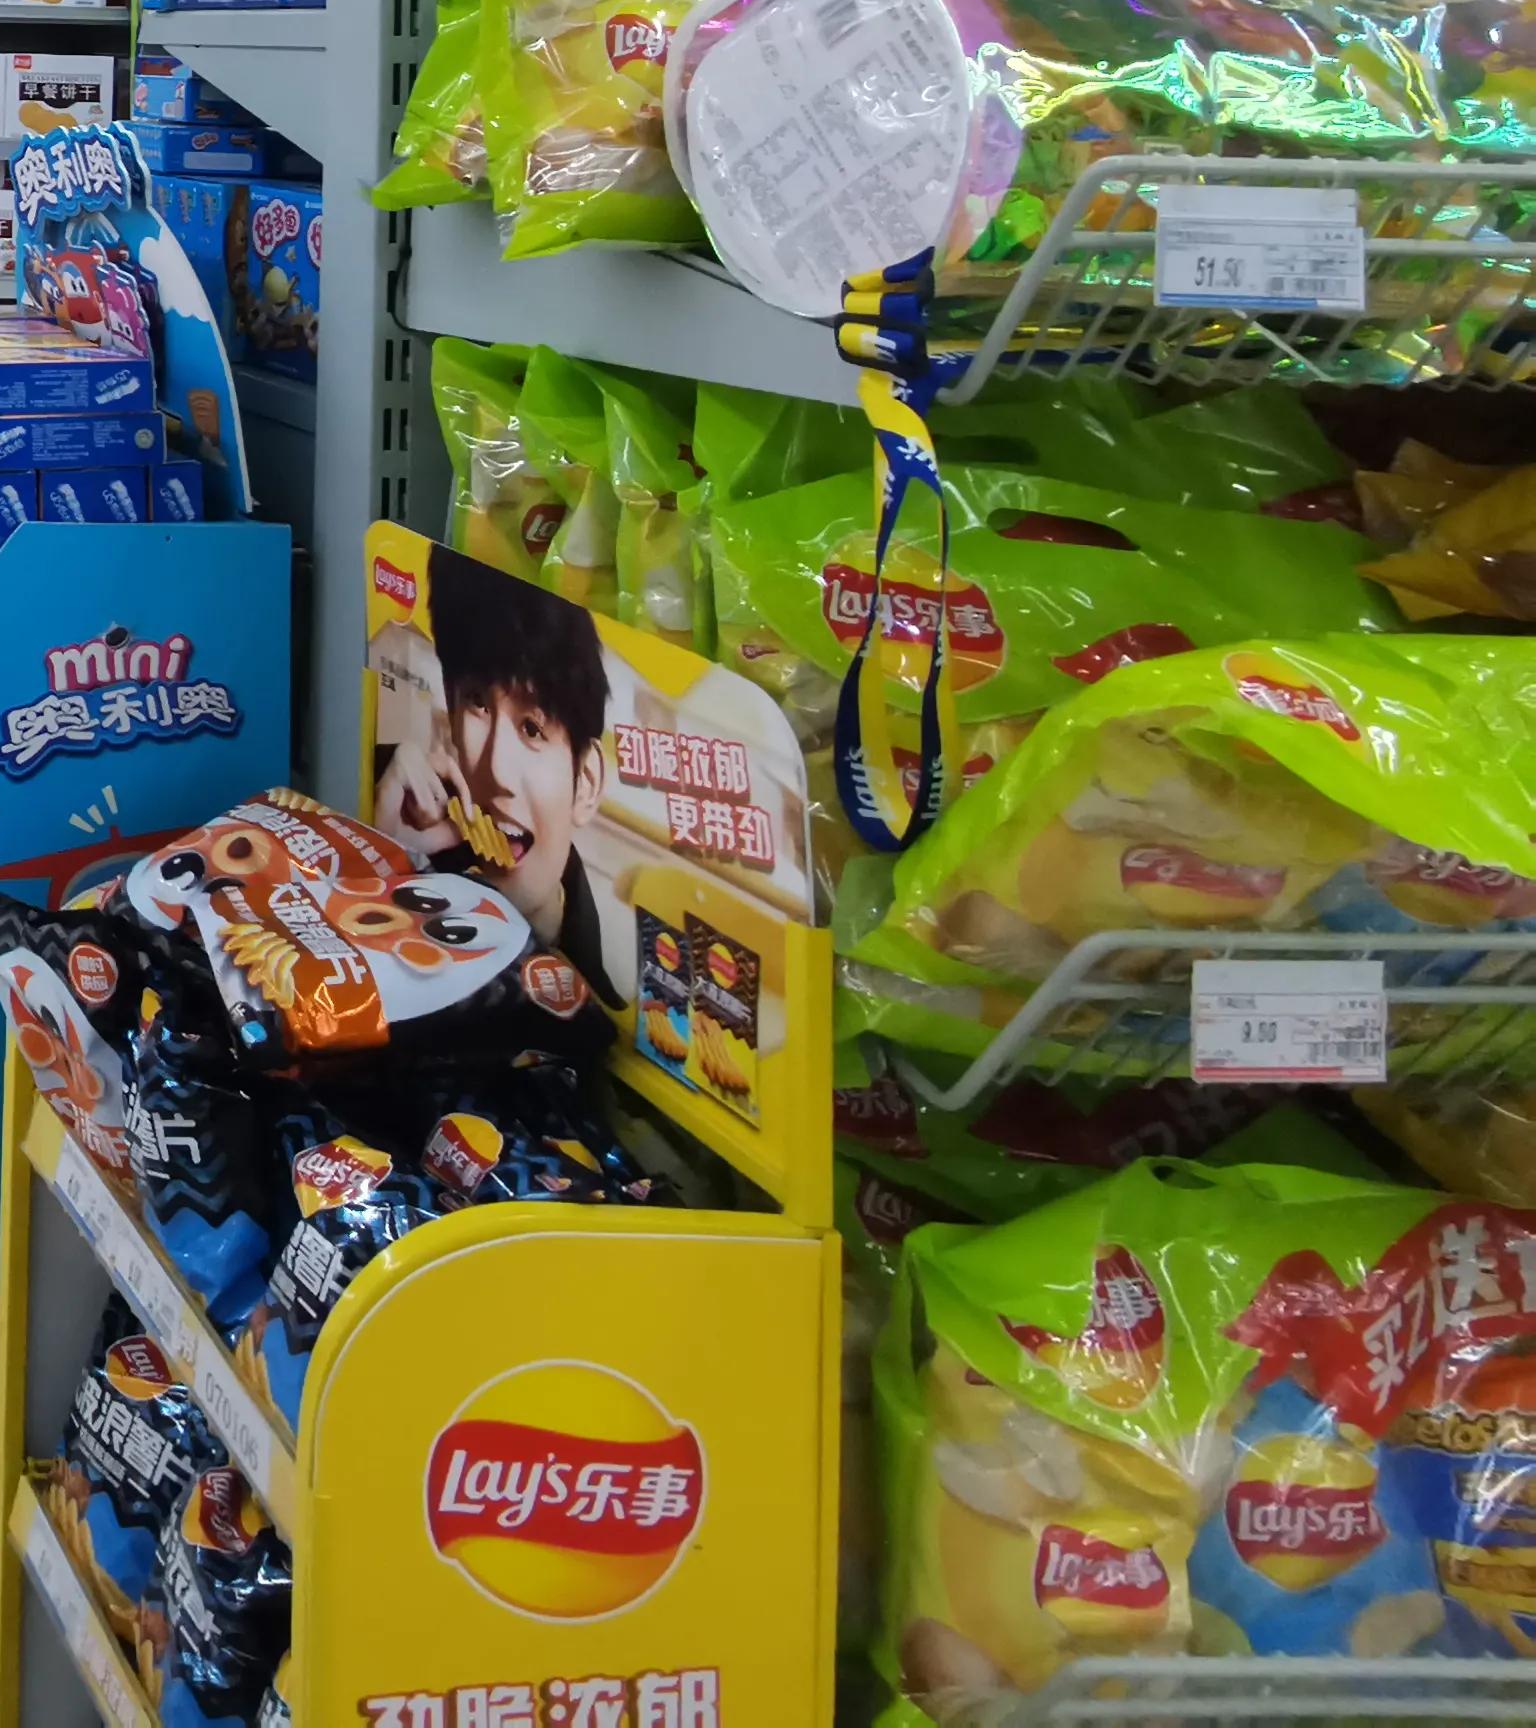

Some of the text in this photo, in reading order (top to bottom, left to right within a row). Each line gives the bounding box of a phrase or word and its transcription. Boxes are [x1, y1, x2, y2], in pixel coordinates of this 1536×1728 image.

[23, 83, 97, 101] 早餐饼干
[15, 140, 122, 225] 奥利奥
[253, 203, 299, 253] 好多鱼
[50, 634, 186, 689] mini
[0, 683, 235, 763] 奥利奥
[615, 724, 750, 797] 劲脆浓郁
[667, 794, 776, 868] 更带劲
